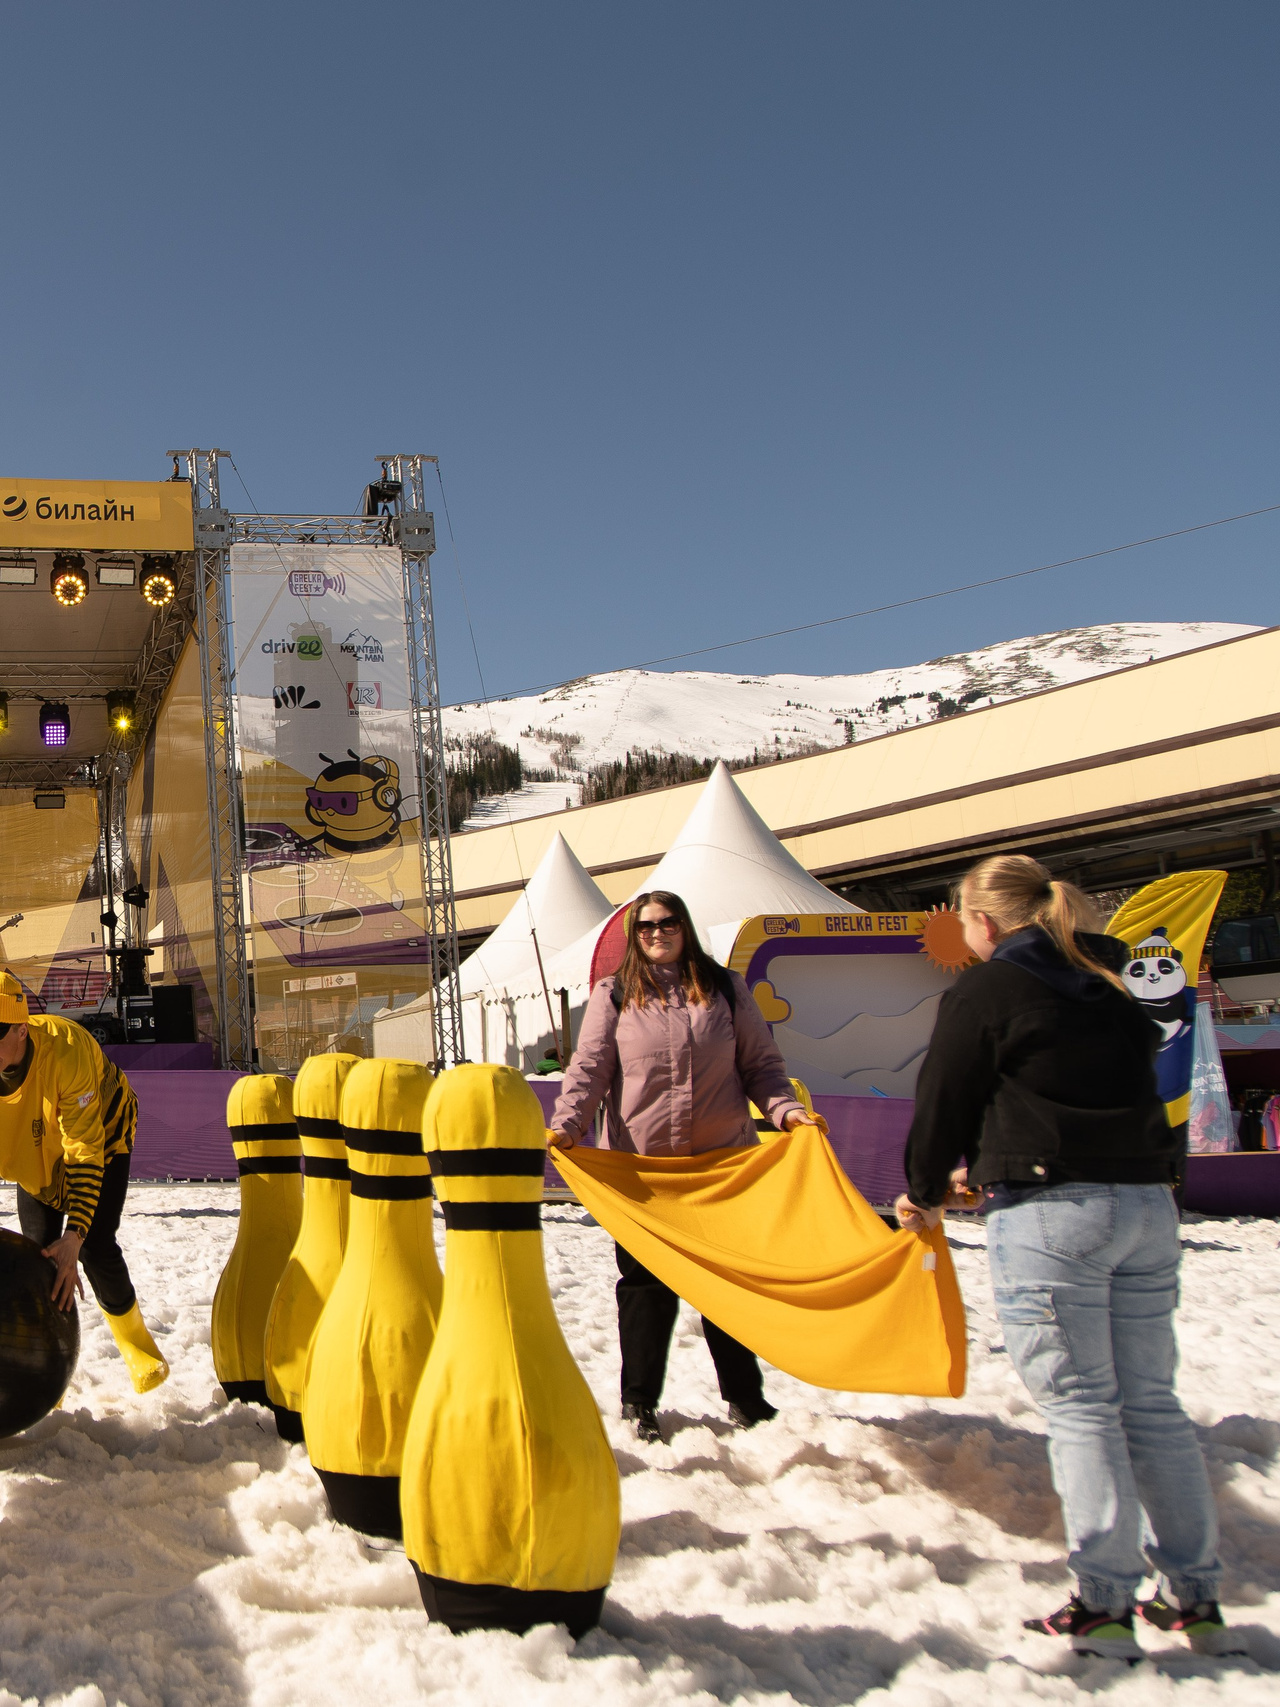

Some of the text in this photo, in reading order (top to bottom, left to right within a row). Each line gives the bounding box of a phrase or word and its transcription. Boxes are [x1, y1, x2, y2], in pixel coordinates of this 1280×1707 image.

[35, 496, 135, 522] билайн
[294, 573, 322, 583] GRELKA
[294, 583, 313, 593] FEST
[261, 639, 323, 656] drivee
[340, 644, 384, 654] MOUNTAIN
[364, 654, 385, 663] MAN
[825, 915, 908, 932] GRELKA FEST
